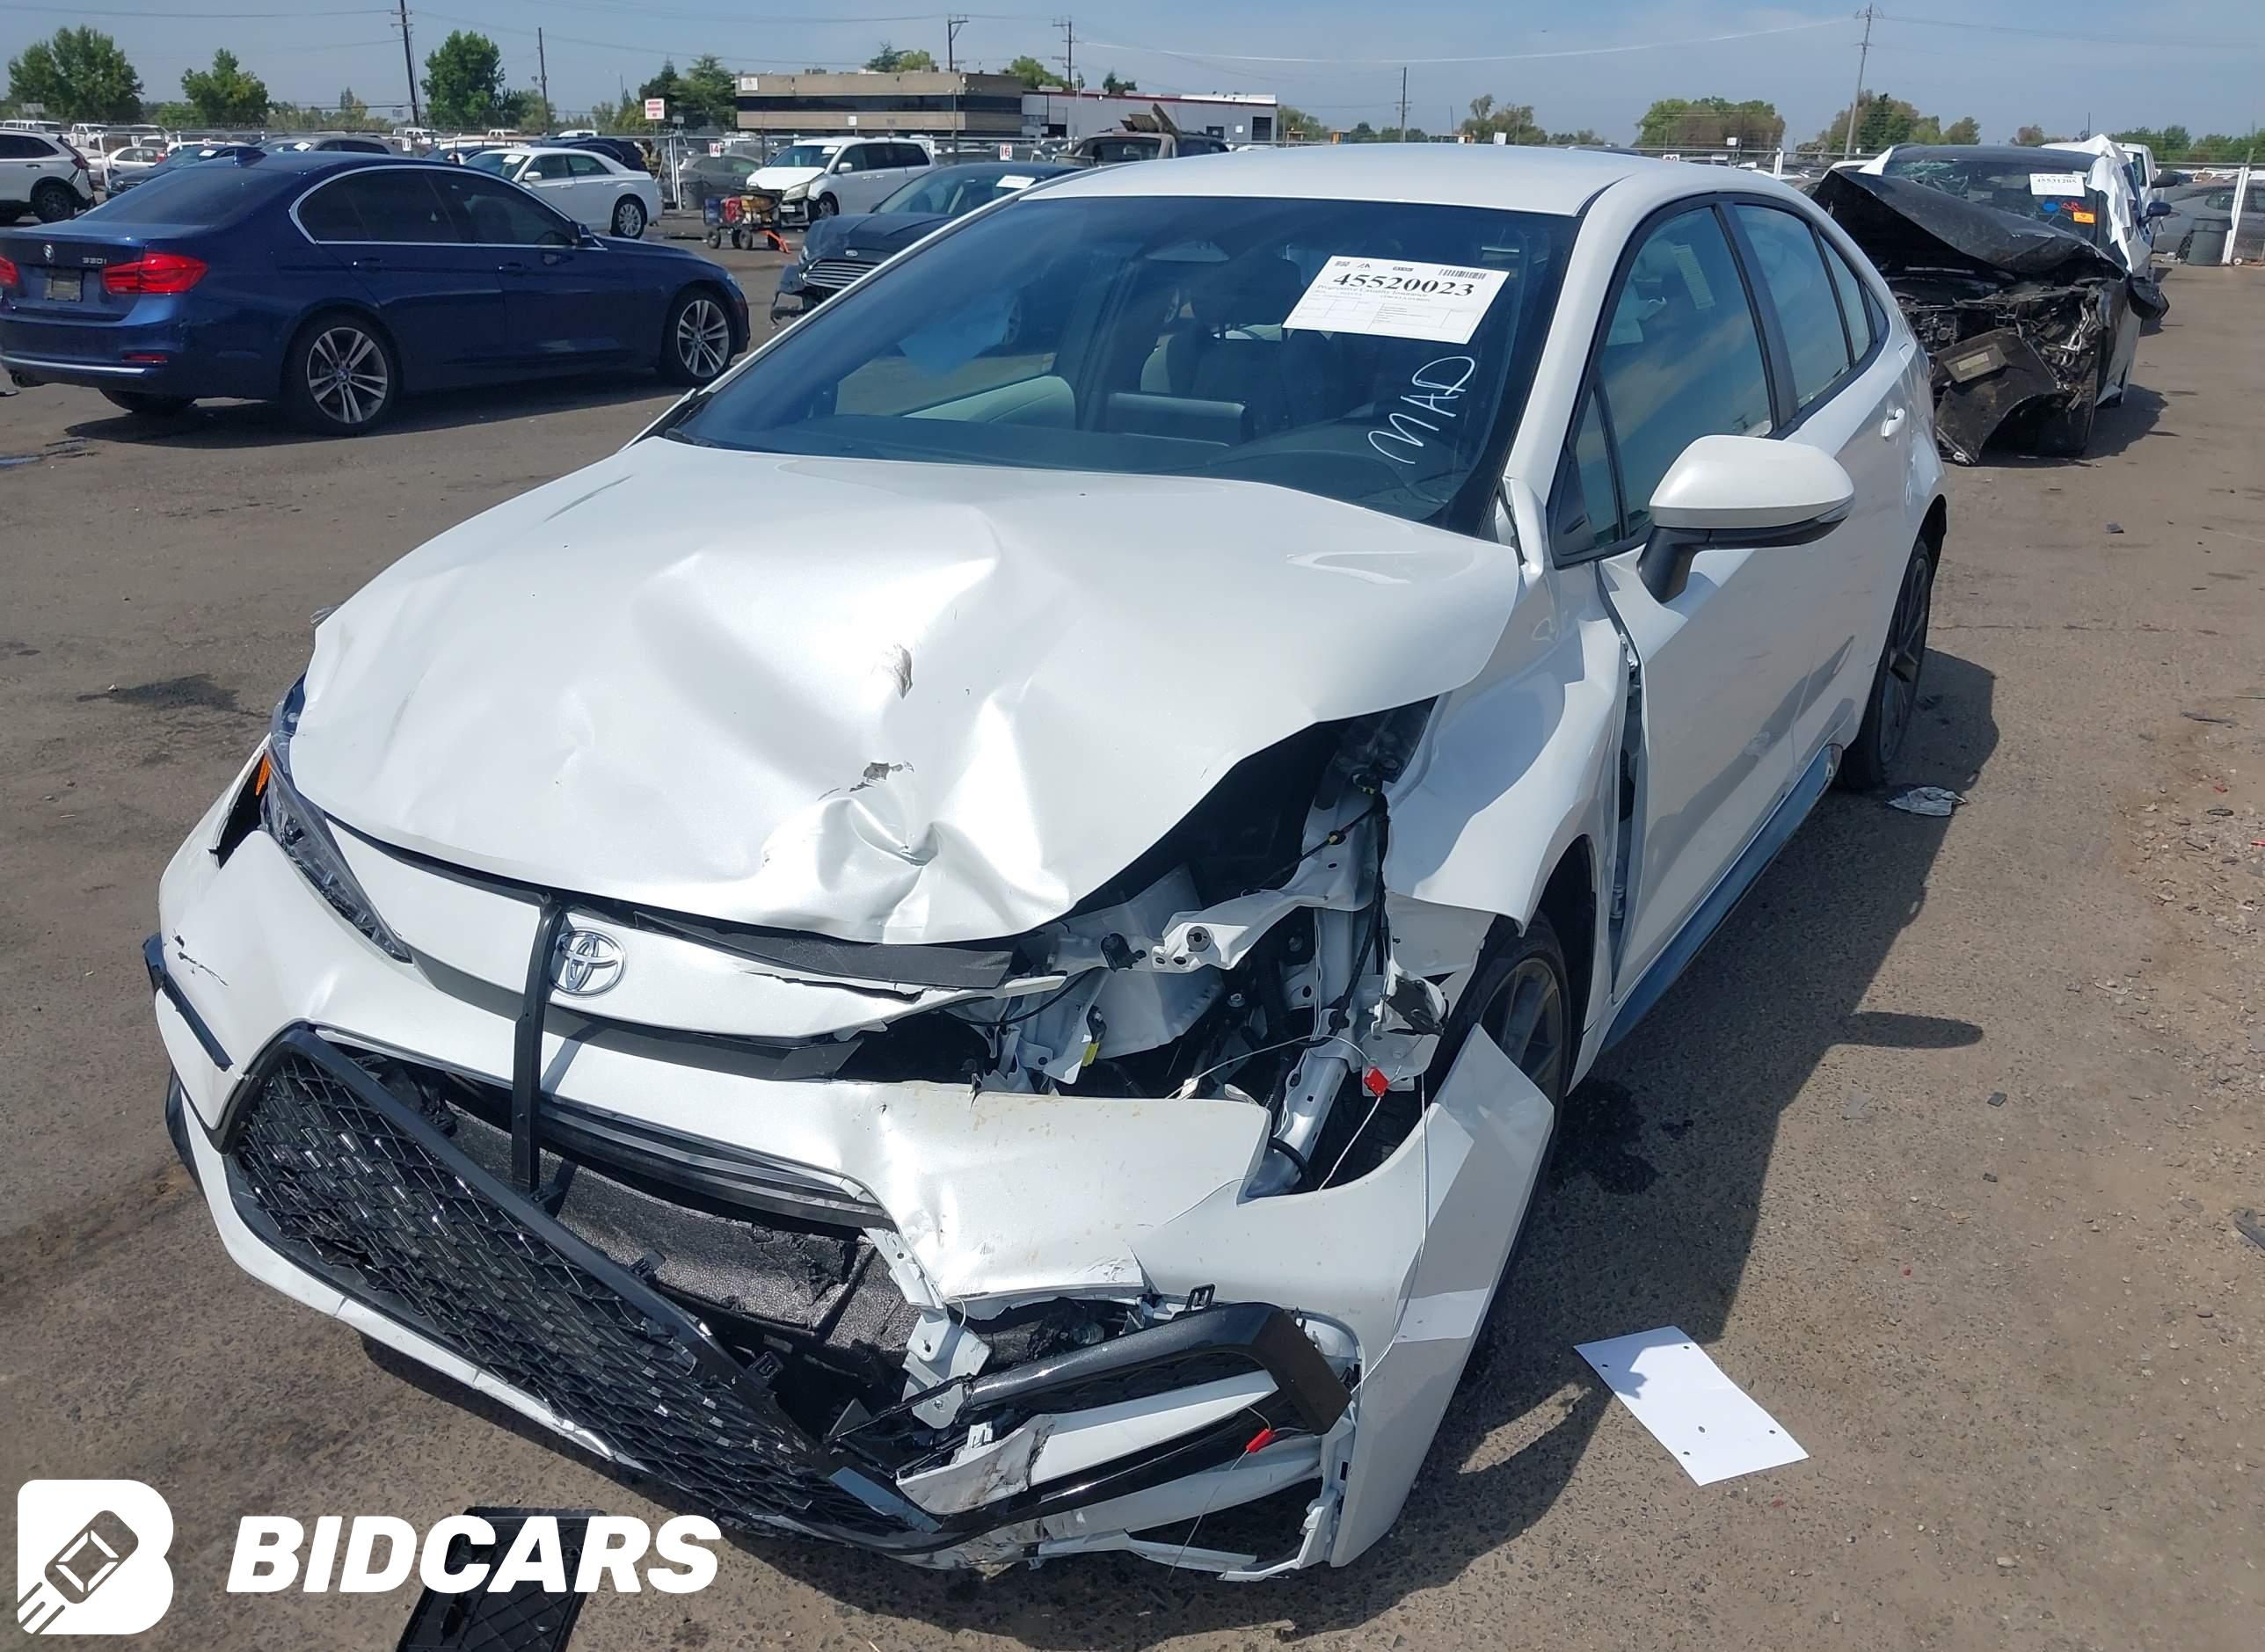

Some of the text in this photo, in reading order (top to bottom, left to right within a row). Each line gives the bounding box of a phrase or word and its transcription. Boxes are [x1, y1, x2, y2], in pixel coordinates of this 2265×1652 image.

[710, 144, 719, 154] 14
[1001, 146, 1010, 156] 16
[1333, 273, 1475, 297] 45520023
